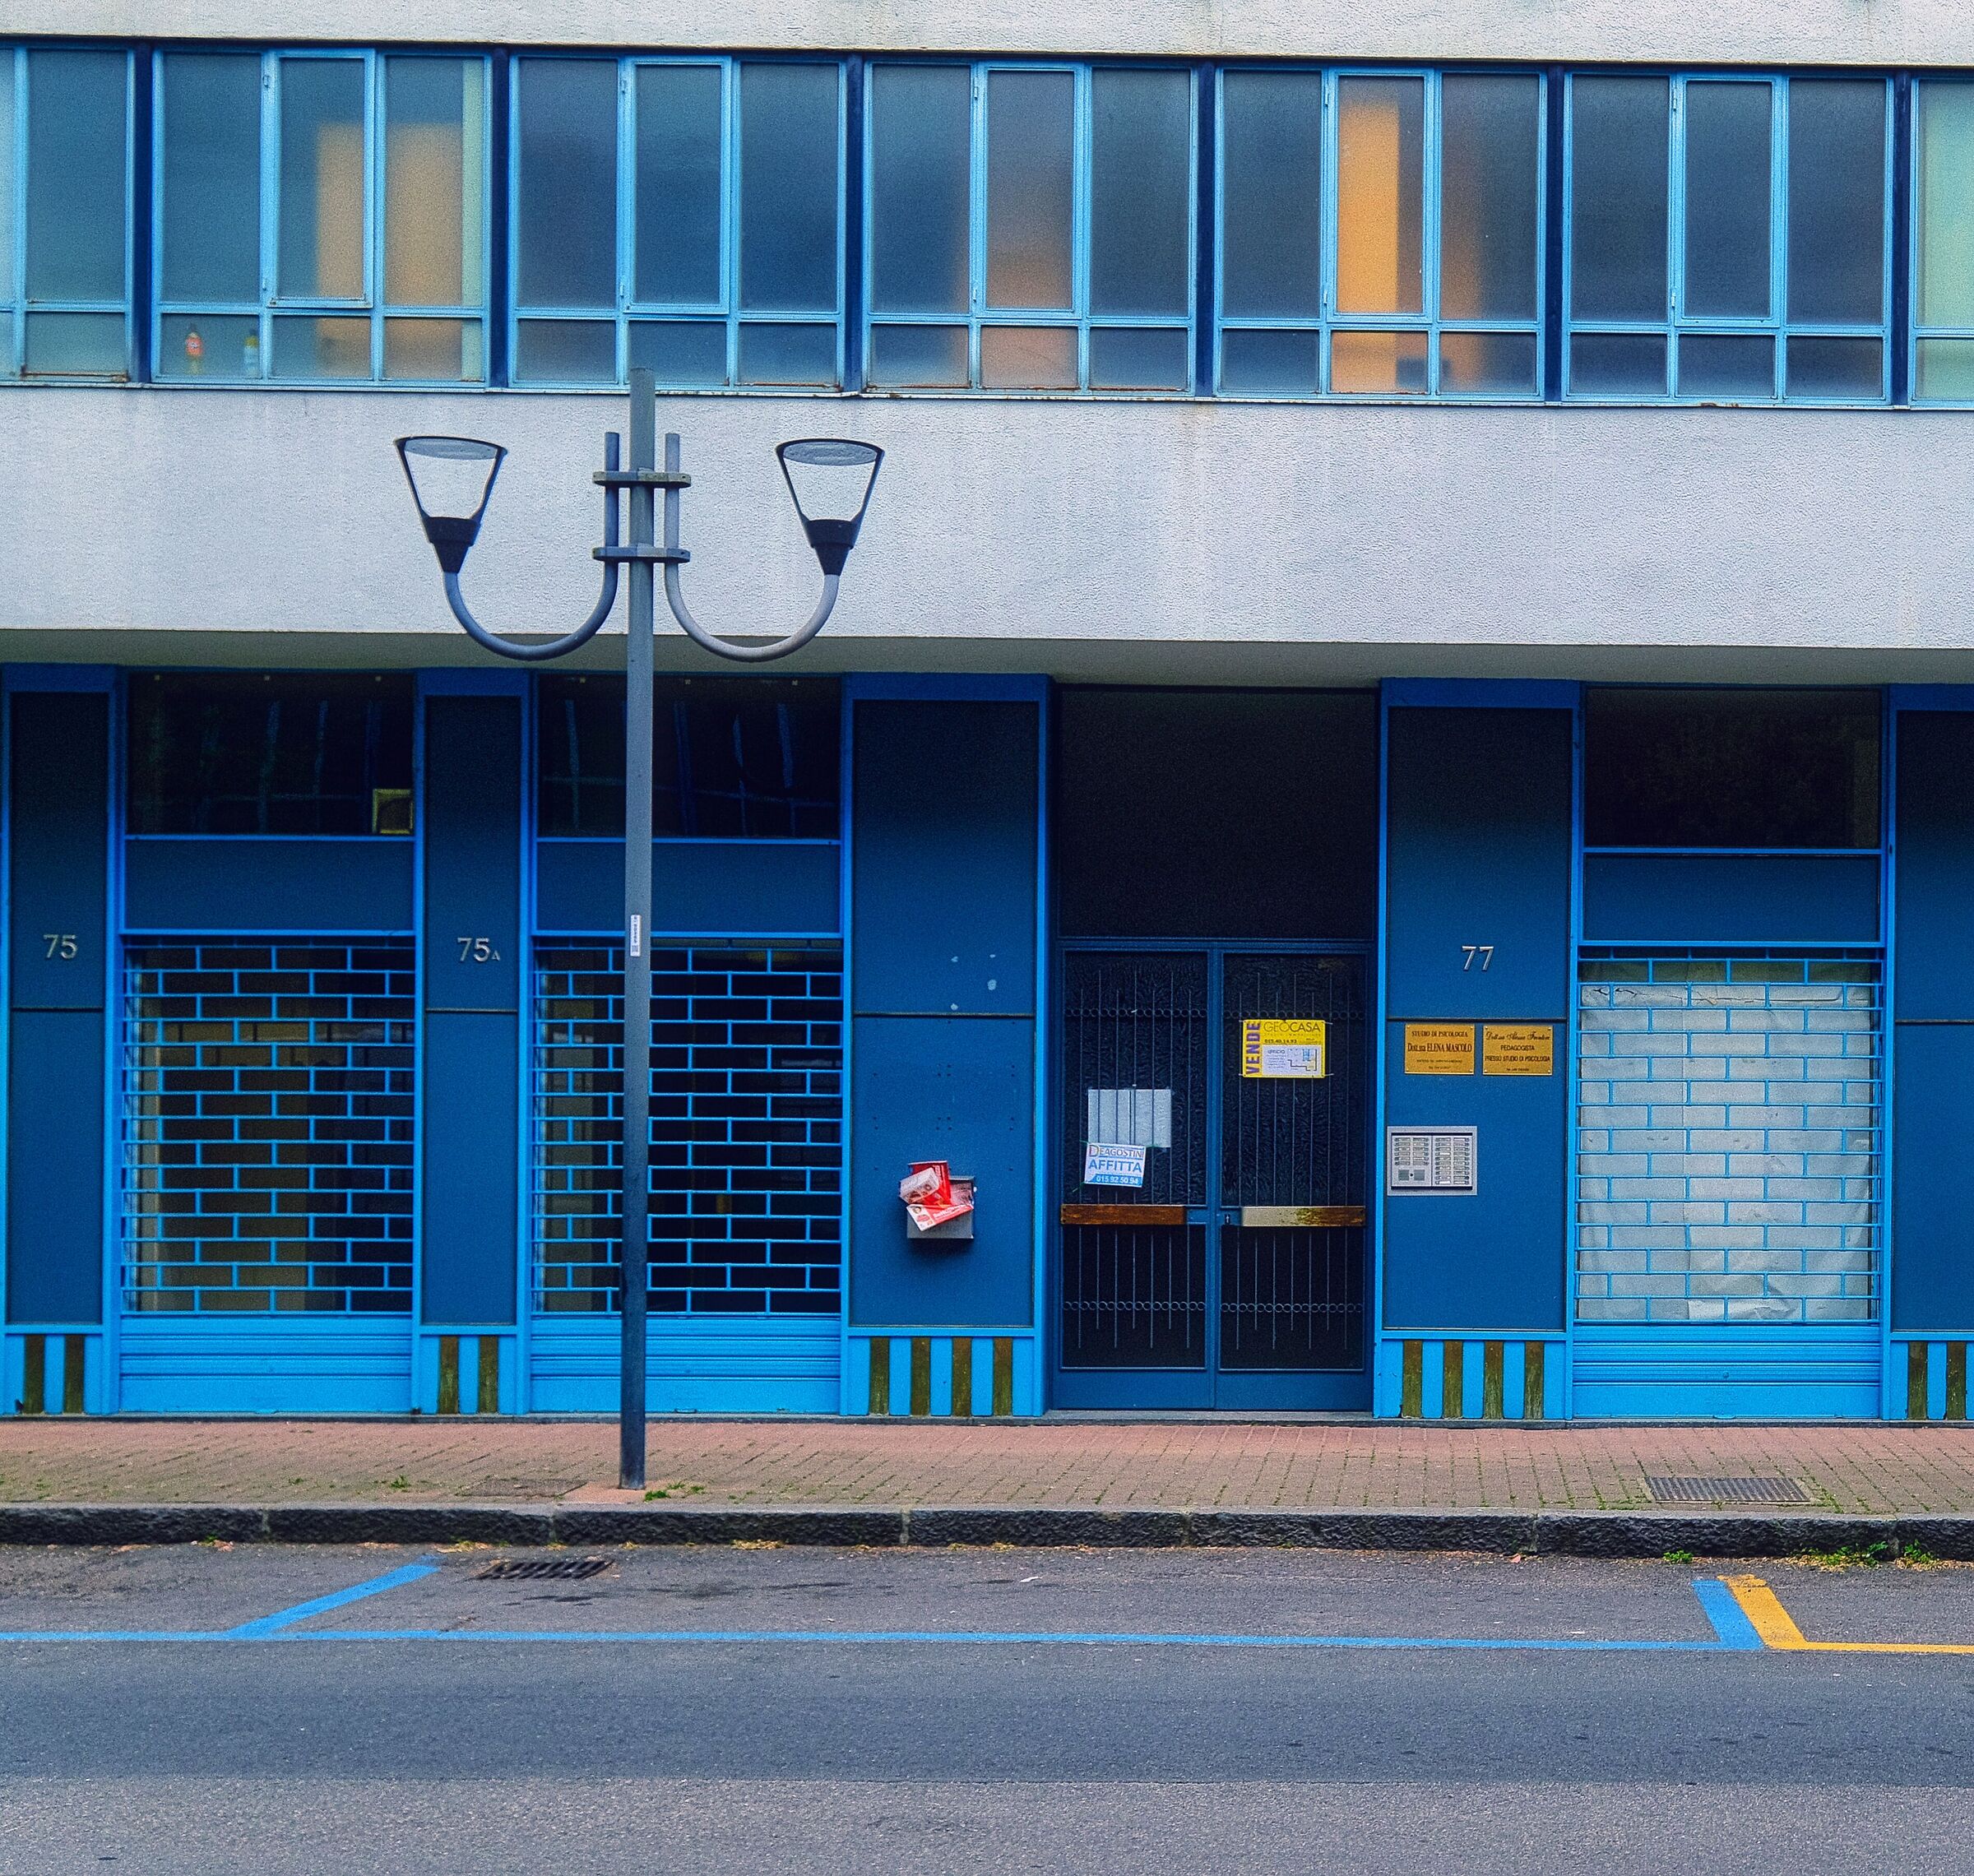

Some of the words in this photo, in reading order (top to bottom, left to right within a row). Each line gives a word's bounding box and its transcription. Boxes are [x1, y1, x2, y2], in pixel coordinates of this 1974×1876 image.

[43, 933, 78, 959] 75
[1462, 946, 1494, 970] 77
[1263, 1021, 1321, 1033] GEOCASA
[1245, 1021, 1261, 1075] VENDE
[1427, 1043, 1445, 1052] ELENA
[1088, 1159, 1142, 1173] AFFITTA
